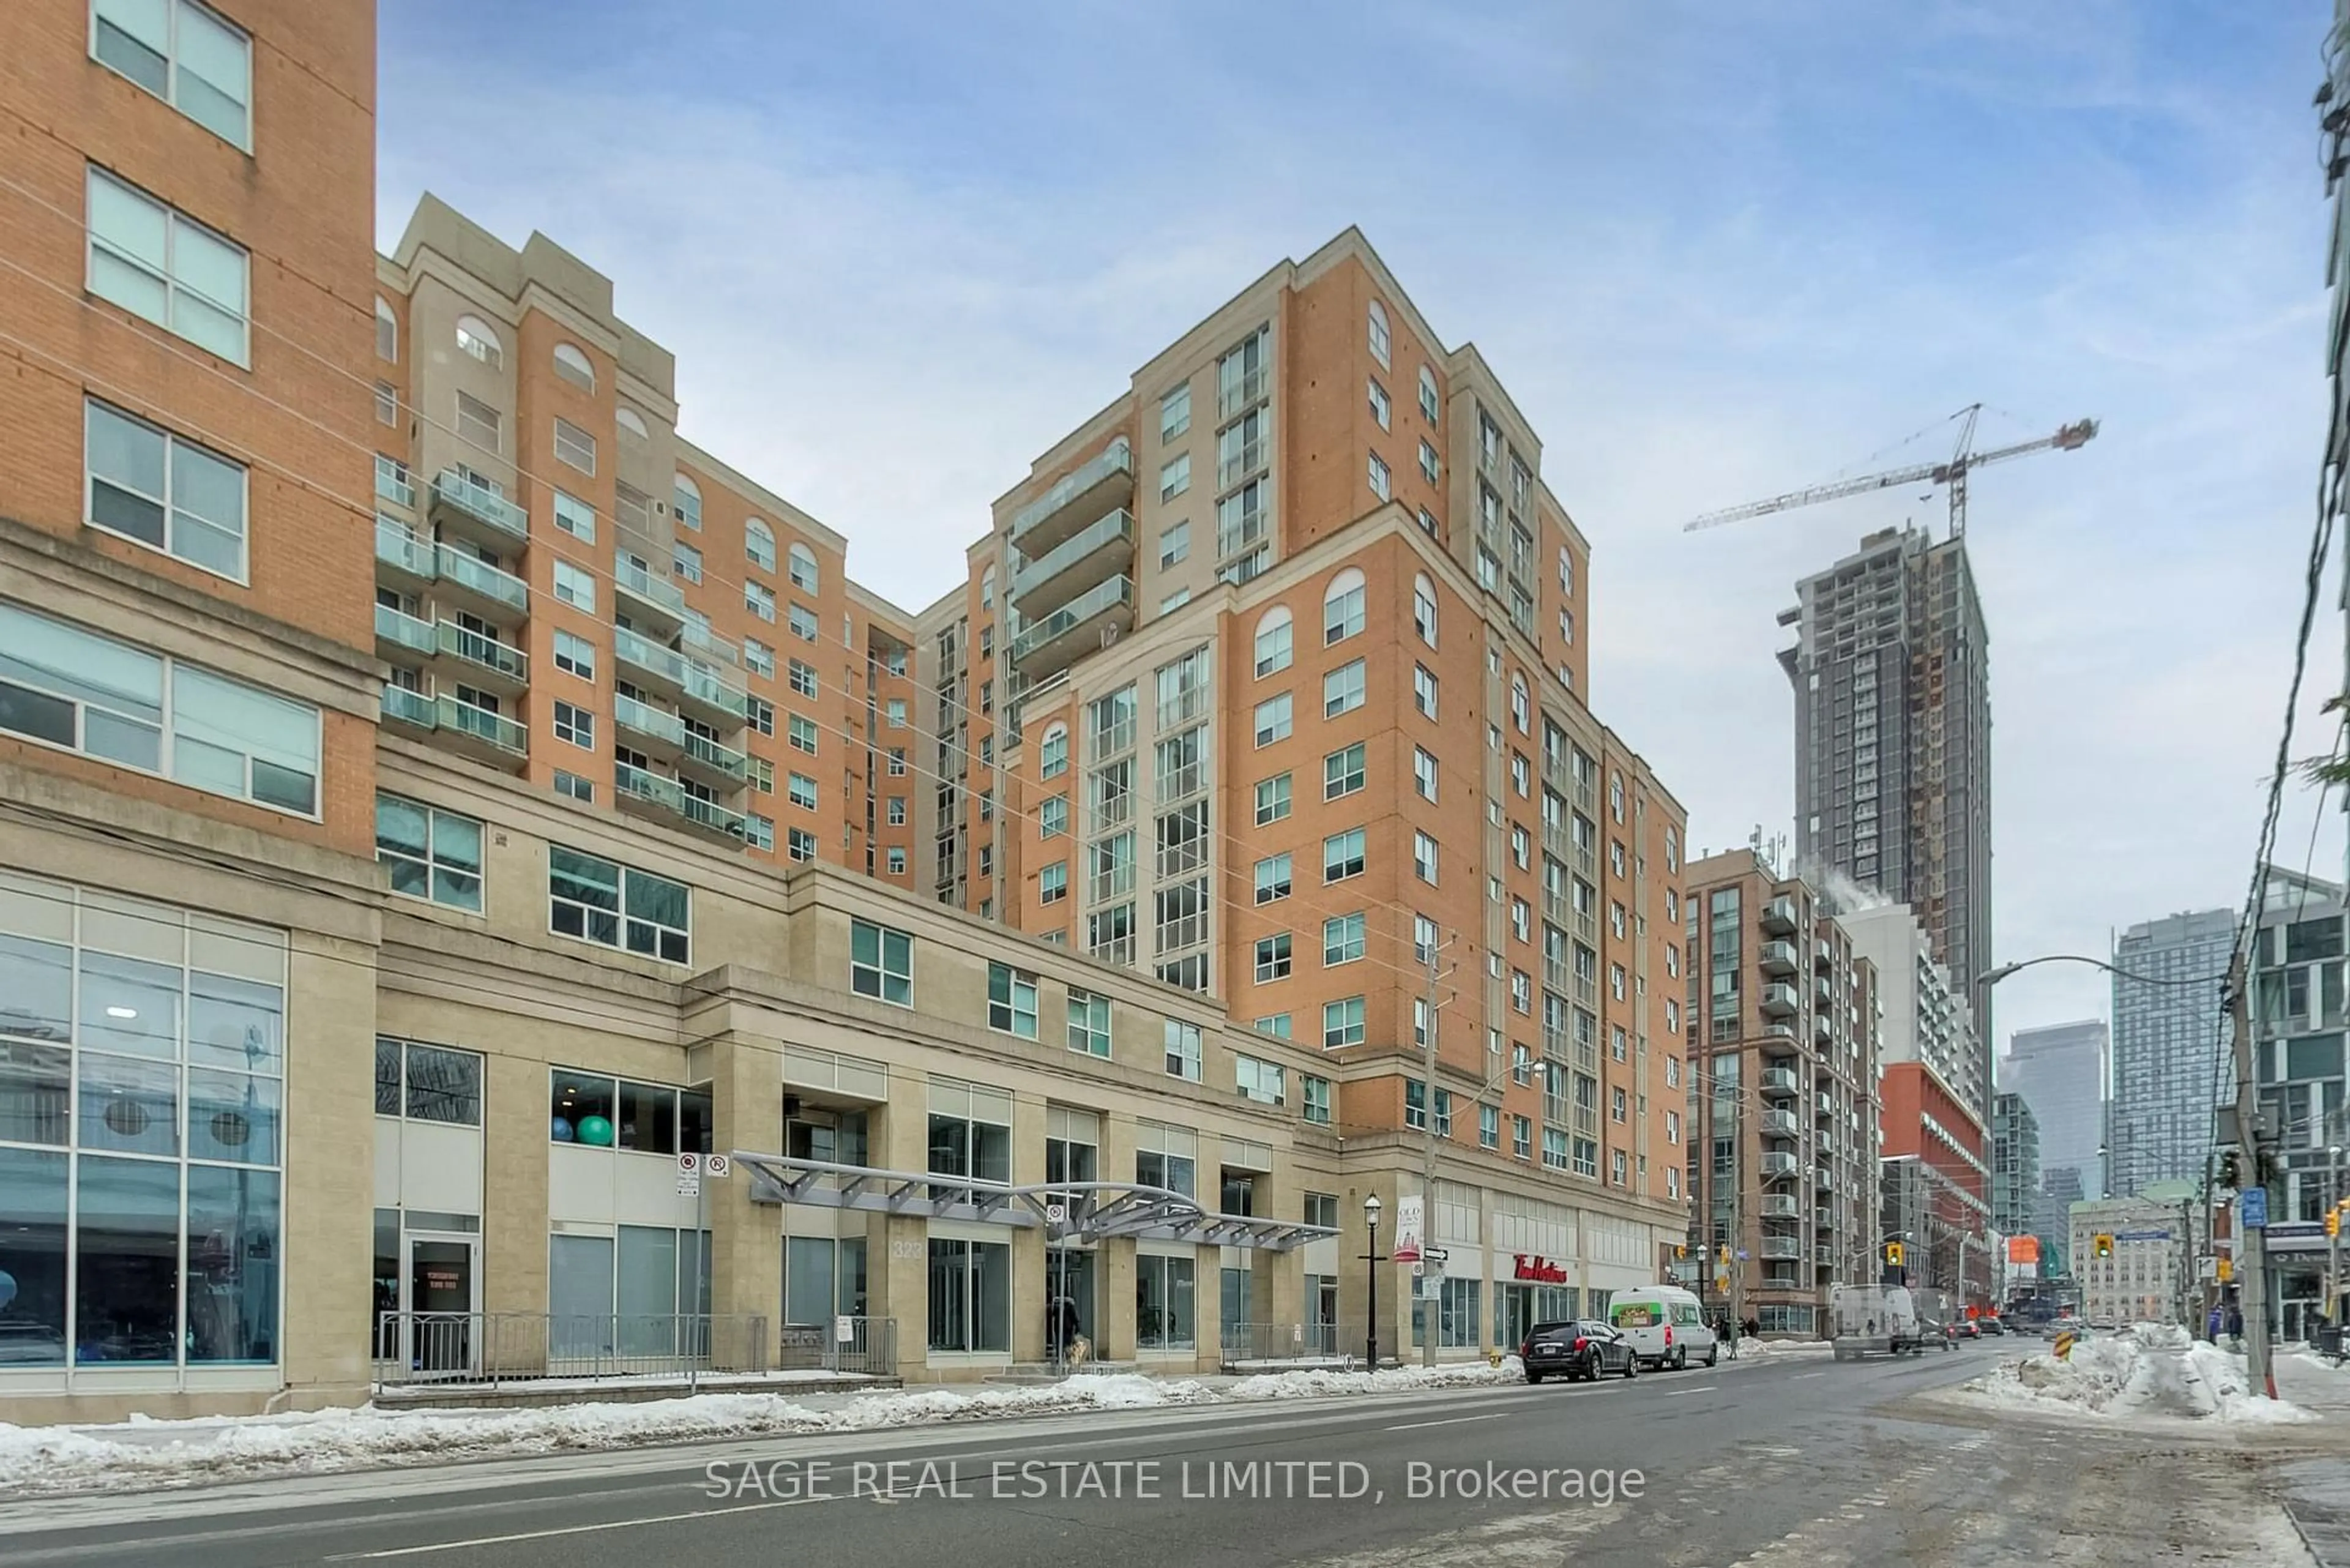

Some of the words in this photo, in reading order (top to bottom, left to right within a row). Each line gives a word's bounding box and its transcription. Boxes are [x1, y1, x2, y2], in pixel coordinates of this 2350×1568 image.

[893, 1241, 922, 1259] 323
[1513, 1254, 1534, 1280] Tim
[1532, 1255, 1567, 1283] Hortons
